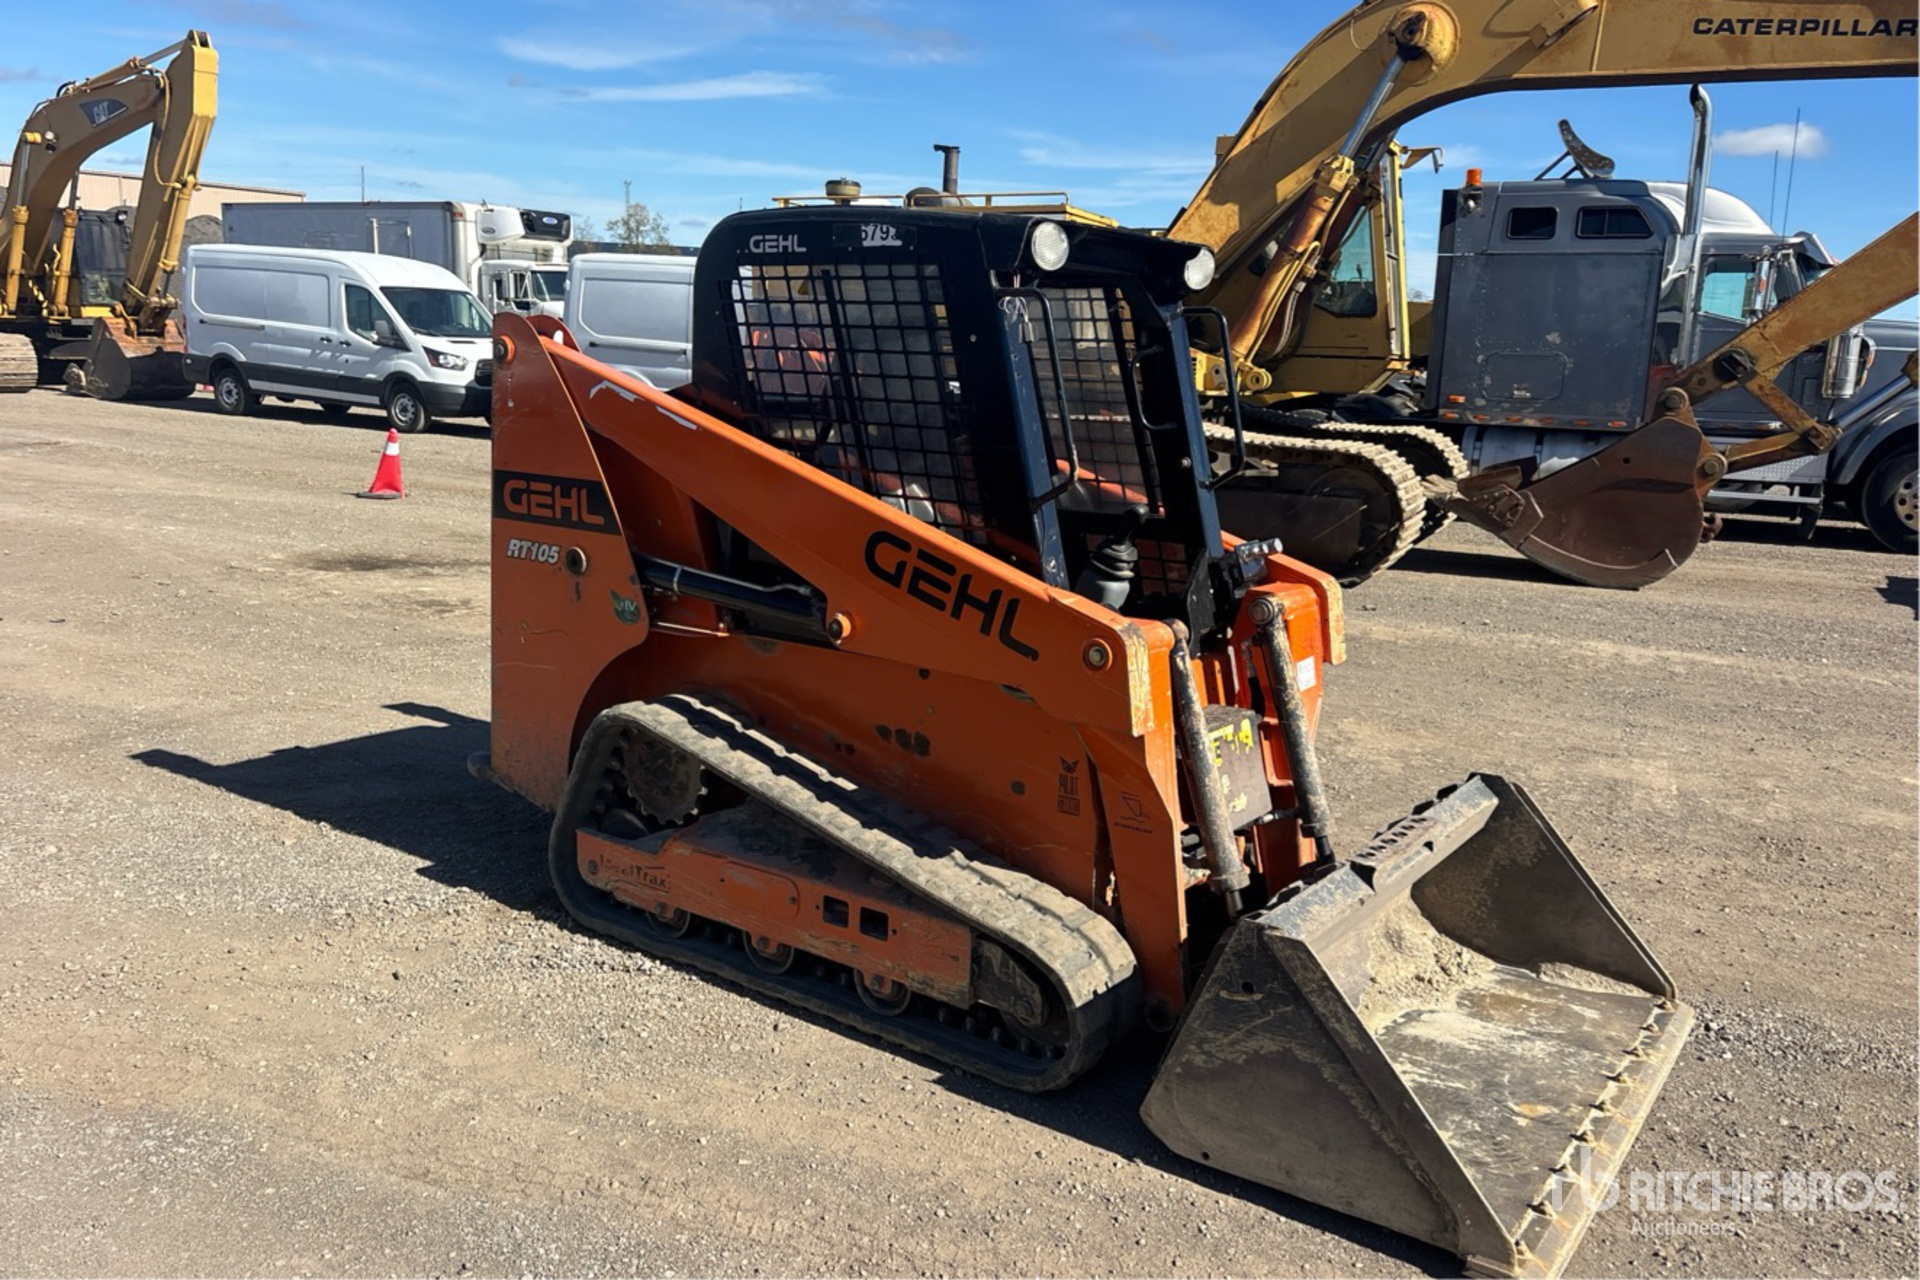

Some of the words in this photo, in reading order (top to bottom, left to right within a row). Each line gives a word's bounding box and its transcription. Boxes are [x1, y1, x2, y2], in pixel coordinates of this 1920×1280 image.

[1693, 18, 1918, 36] CATERPILLAR
[750, 234, 807, 253] GEHL
[503, 479, 605, 526] GEHL
[506, 538, 561, 564] RT105
[864, 530, 1040, 662] GEHL
